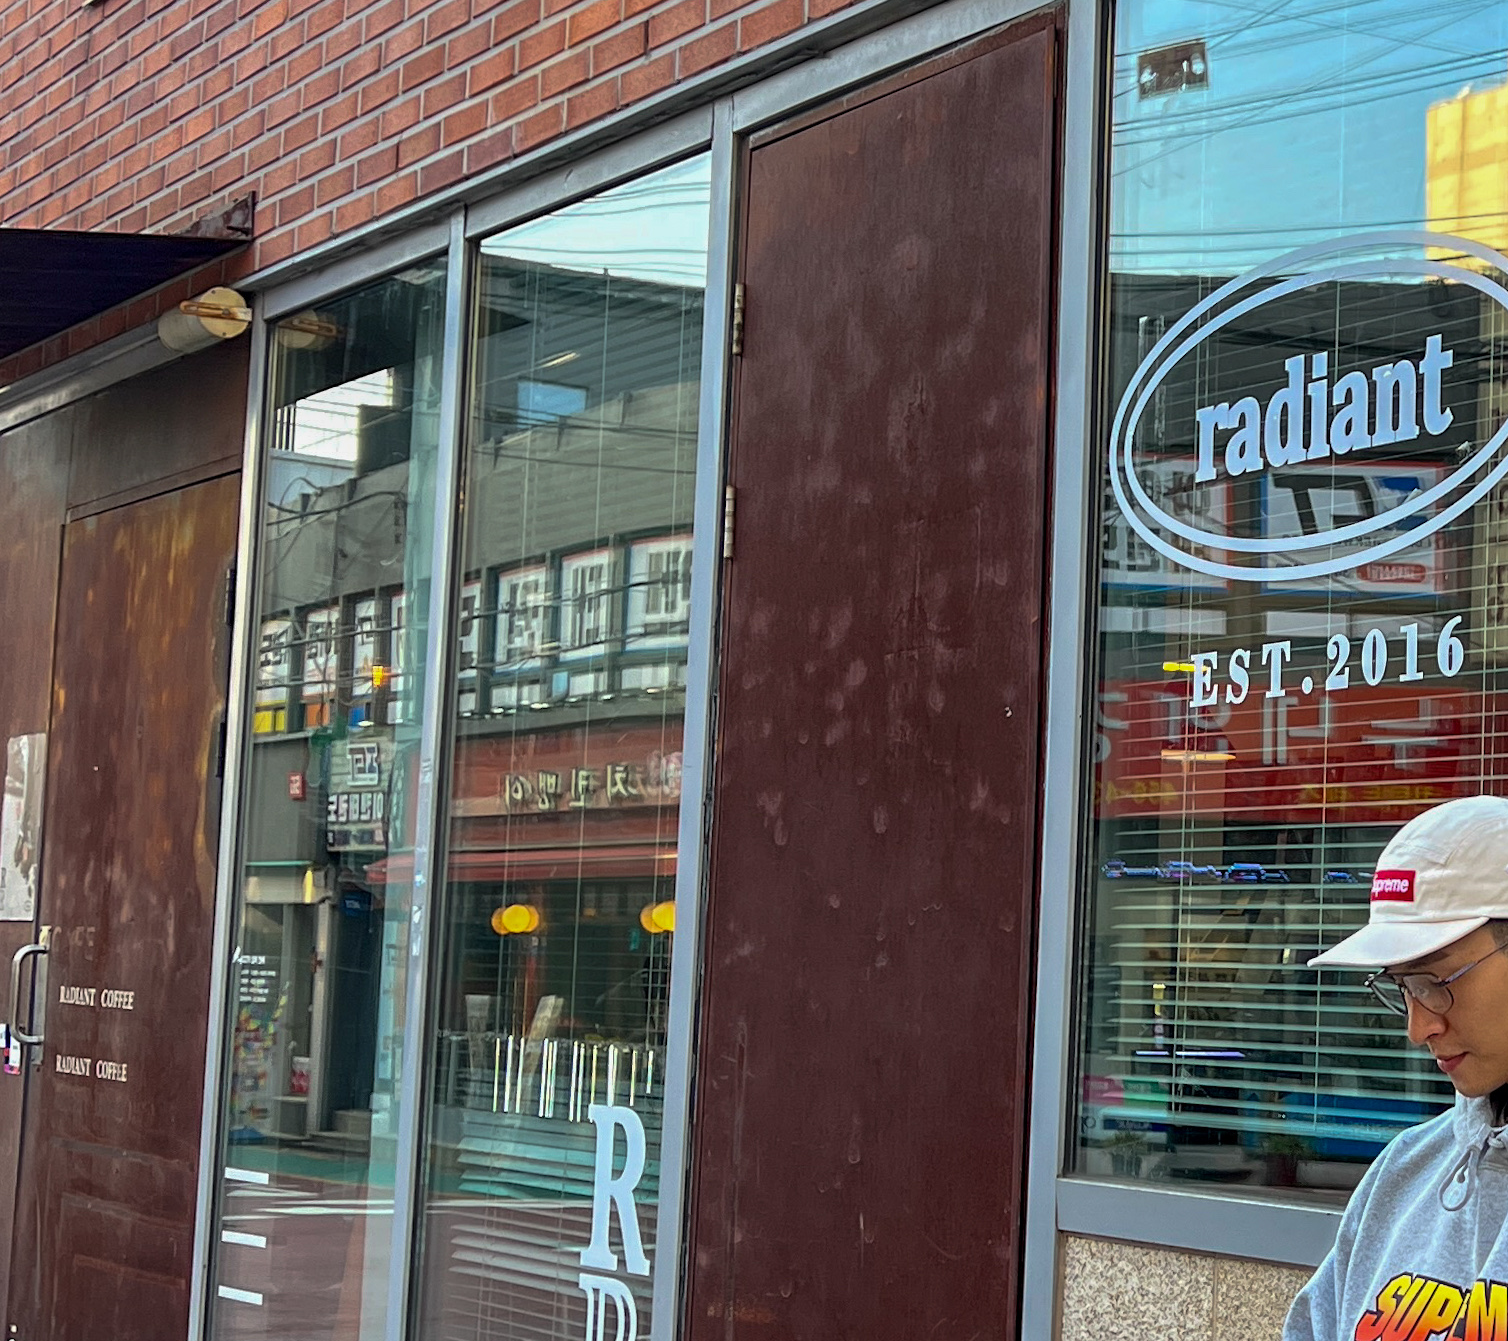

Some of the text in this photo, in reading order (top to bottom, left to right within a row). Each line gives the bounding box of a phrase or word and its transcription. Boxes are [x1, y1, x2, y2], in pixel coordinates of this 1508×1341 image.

[1195, 333, 1455, 483] radiant
[1189, 615, 1466, 709] EST.2016
[1372, 878, 1410, 898] upreme
[59, 985, 135, 1010] RADIANT COFFEE
[55, 1054, 128, 1083] RADIANT COFFEE
[579, 1103, 651, 1277] R
